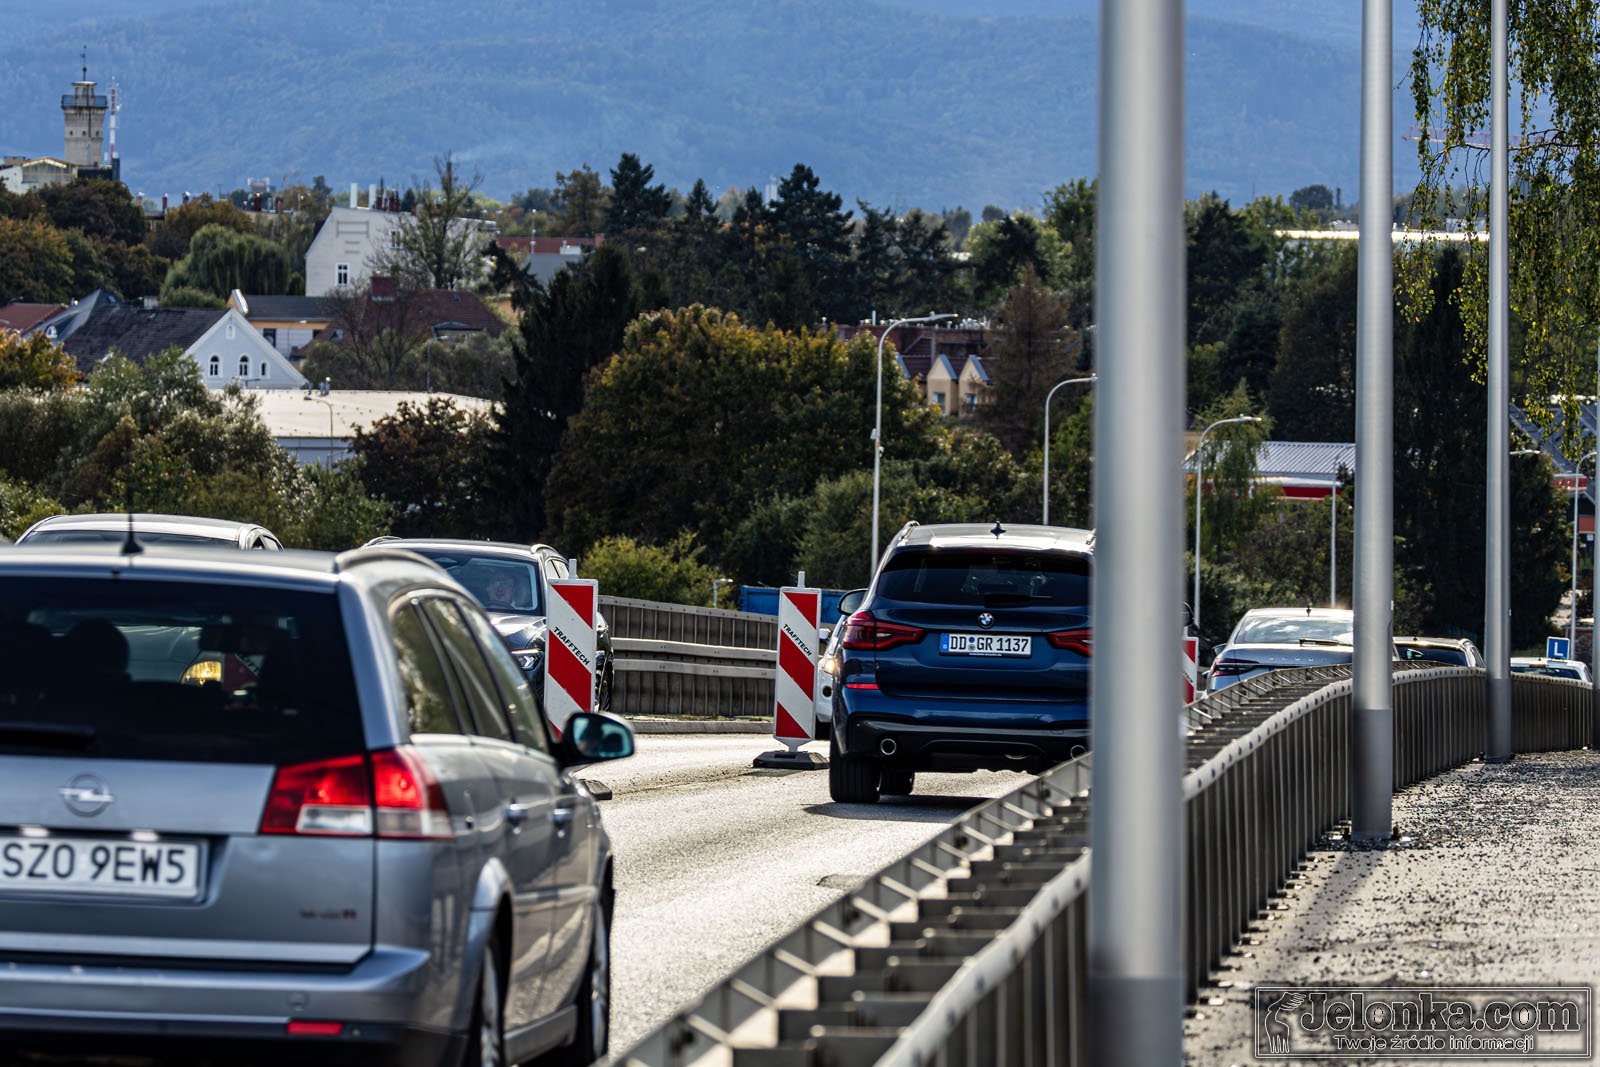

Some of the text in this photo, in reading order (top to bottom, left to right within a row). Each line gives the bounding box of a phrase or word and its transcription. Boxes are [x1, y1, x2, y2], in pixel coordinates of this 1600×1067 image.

[553, 626, 590, 665] TRAFFTECH
[783, 624, 812, 656] TRAFFTECH
[950, 636, 967, 650] DD
[976, 637, 993, 651] GR
[996, 637, 1029, 652] 1137
[1554, 641, 1564, 656] L
[3, 843, 185, 883] SZO 9EW5
